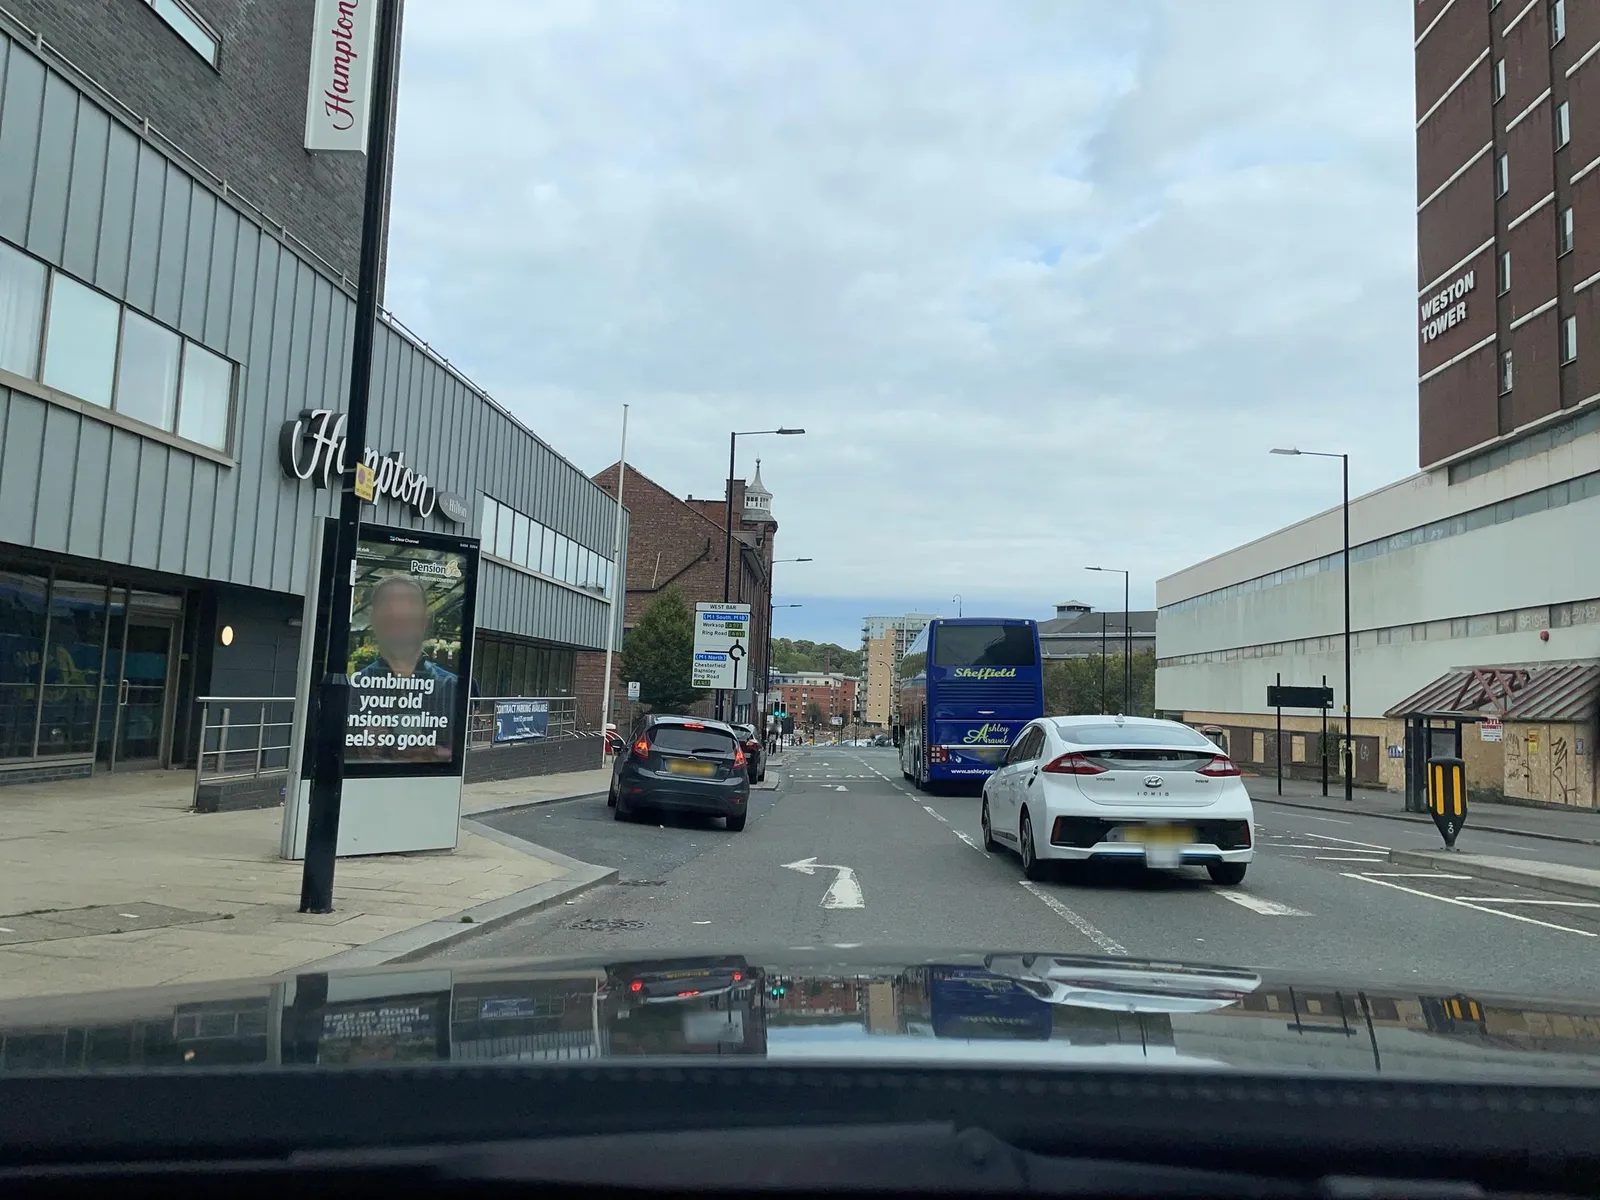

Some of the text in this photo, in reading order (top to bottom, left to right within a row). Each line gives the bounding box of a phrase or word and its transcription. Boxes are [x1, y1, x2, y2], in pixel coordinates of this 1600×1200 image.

[324, 0, 359, 131] Hampton
[1421, 270, 1474, 321] WESTON
[1421, 301, 1466, 344] TOWER
[449, 498, 467, 518] Hilton
[411, 560, 446, 575] Pension
[350, 671, 435, 695] Combining
[954, 667, 1017, 680] Sheffield
[360, 692, 423, 712] your old
[516, 704, 531, 713] PARKING
[347, 710, 449, 728] nsions online
[345, 729, 437, 751] eels so good
